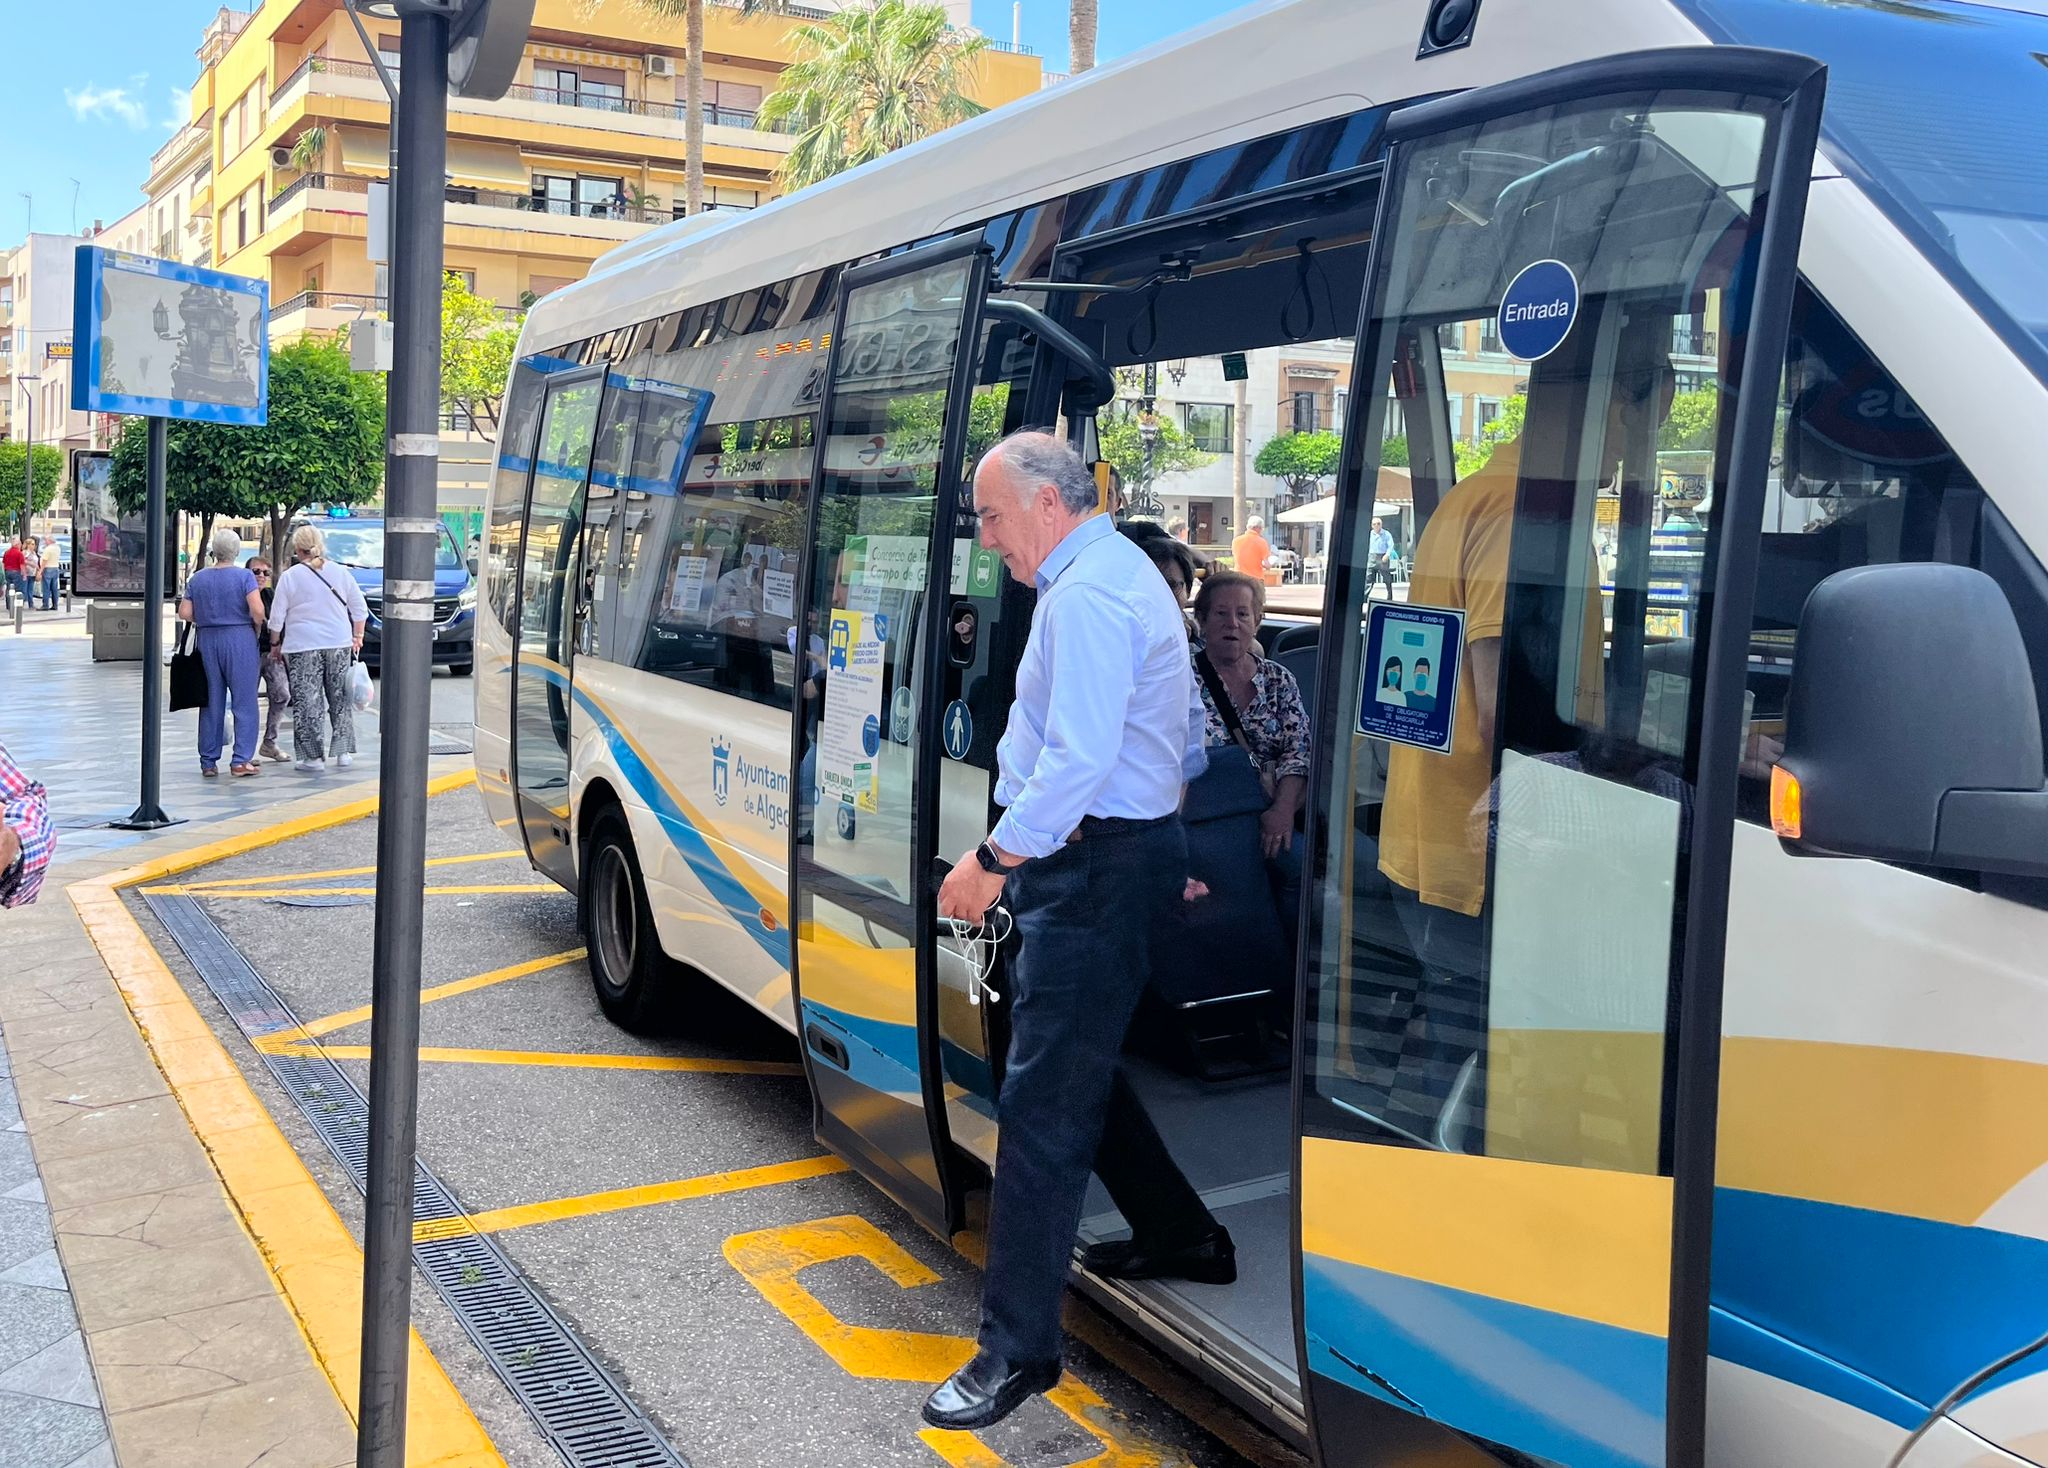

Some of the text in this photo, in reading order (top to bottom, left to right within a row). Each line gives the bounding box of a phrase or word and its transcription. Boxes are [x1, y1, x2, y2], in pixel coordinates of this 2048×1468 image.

[1505, 298, 1569, 322] Entrada
[907, 549, 918, 563] de
[870, 564, 900, 583] Campo
[902, 568, 914, 581] de
[1385, 610, 1445, 625] CORONAVIRUS COVID-19
[1385, 712, 1392, 720] DE
[1395, 714, 1425, 726] MASCARILLA
[1396, 707, 1429, 719] OBLIGATORIO
[735, 754, 790, 795] Ayuntam
[743, 793, 790, 830] de Algec
